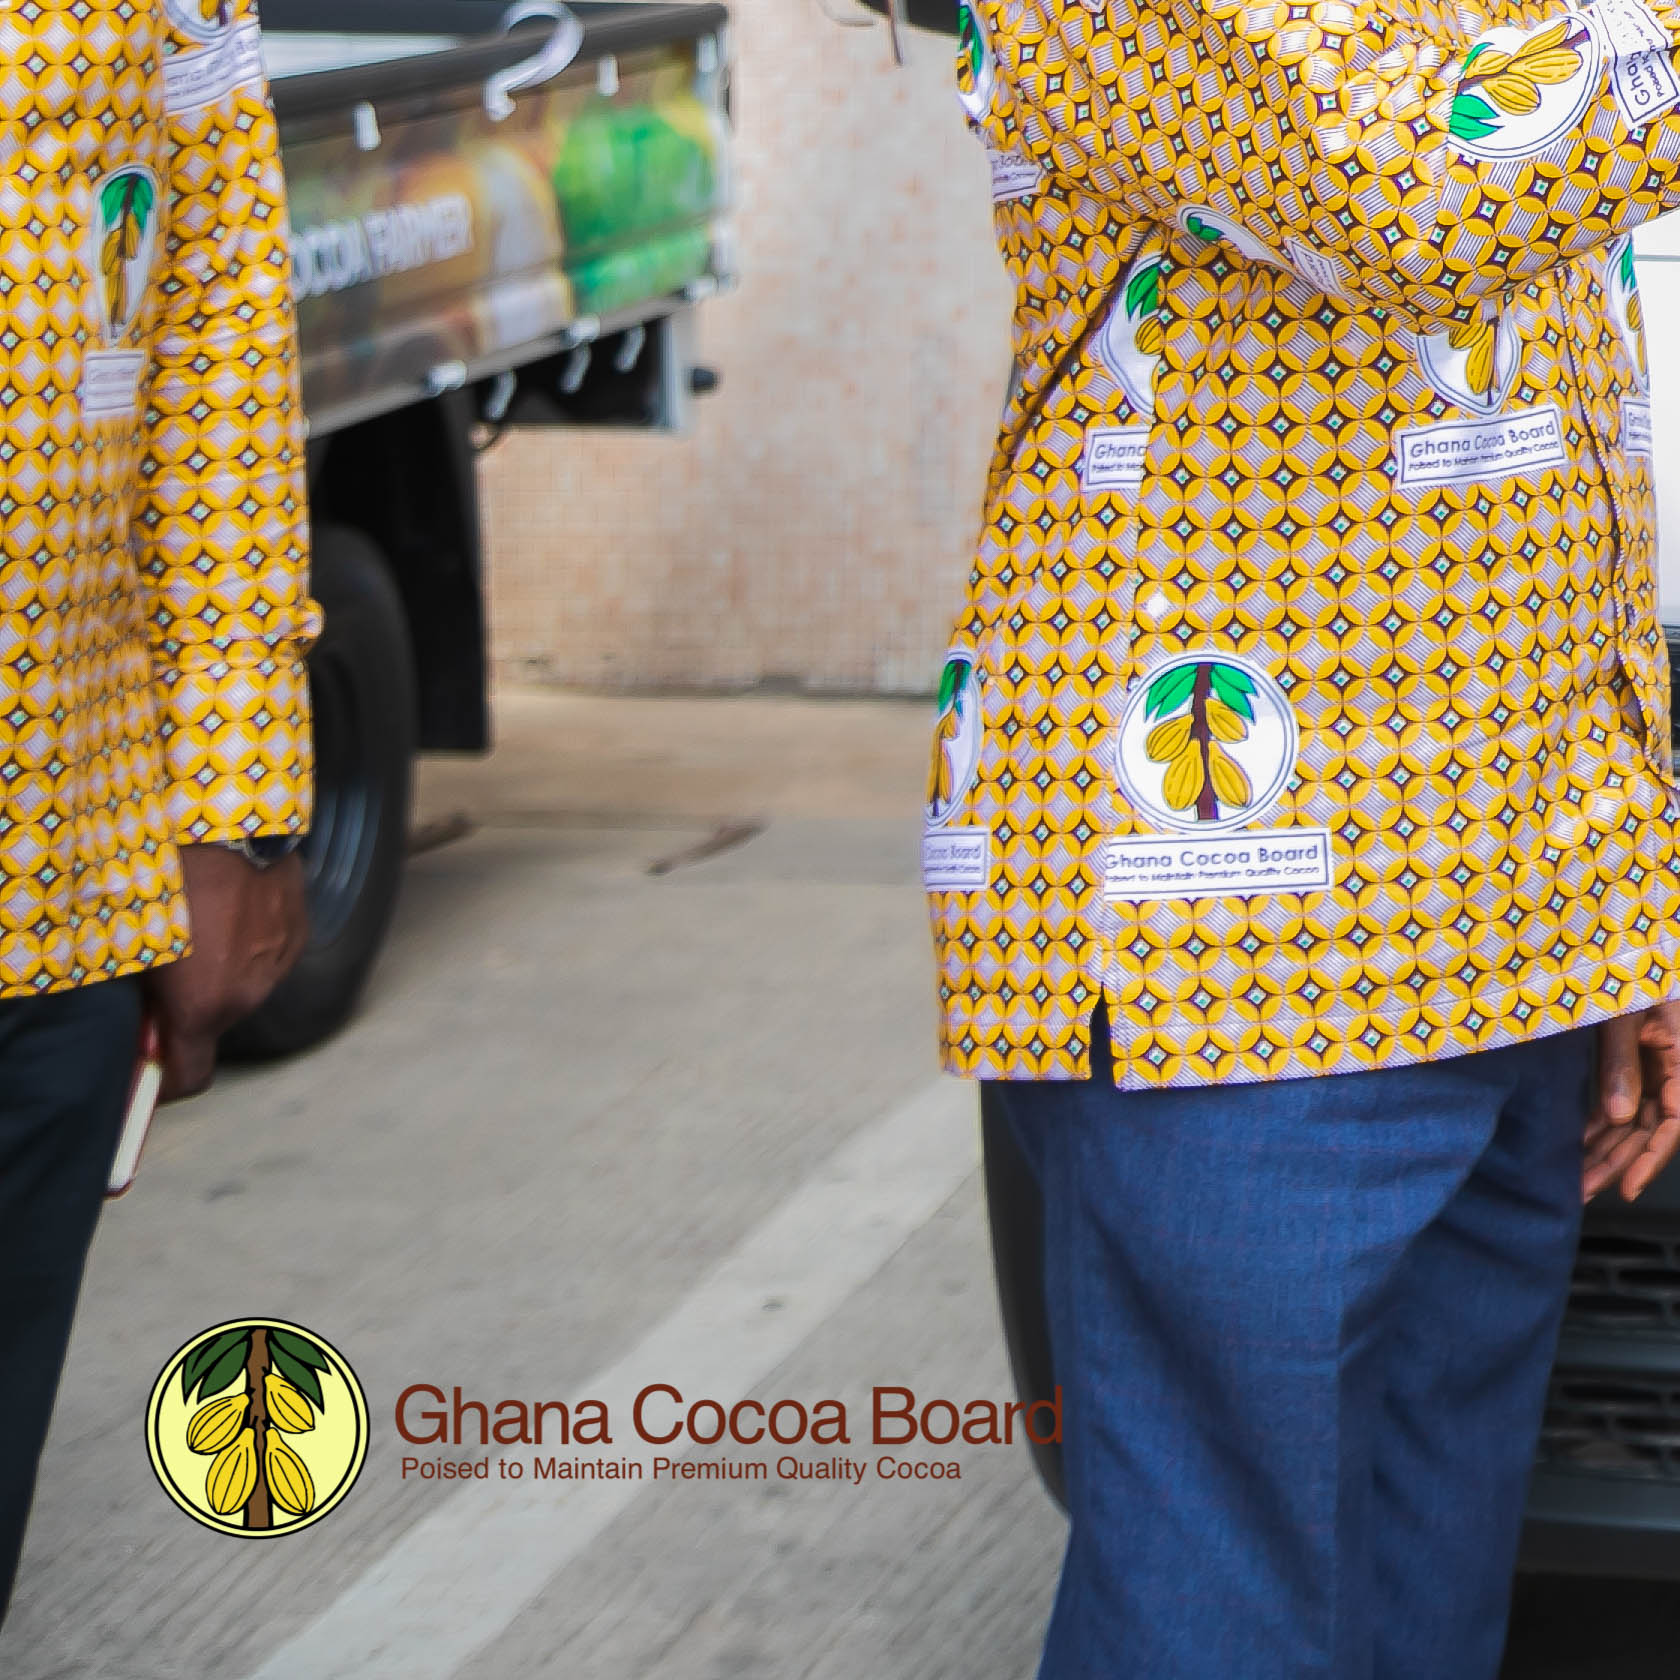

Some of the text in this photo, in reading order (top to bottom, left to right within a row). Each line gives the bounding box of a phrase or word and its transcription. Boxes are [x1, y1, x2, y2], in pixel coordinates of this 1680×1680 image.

[1409, 440, 1470, 458] Ghana
[1508, 421, 1556, 444] Board
[1105, 845, 1318, 869] Ghana Cocoa Board
